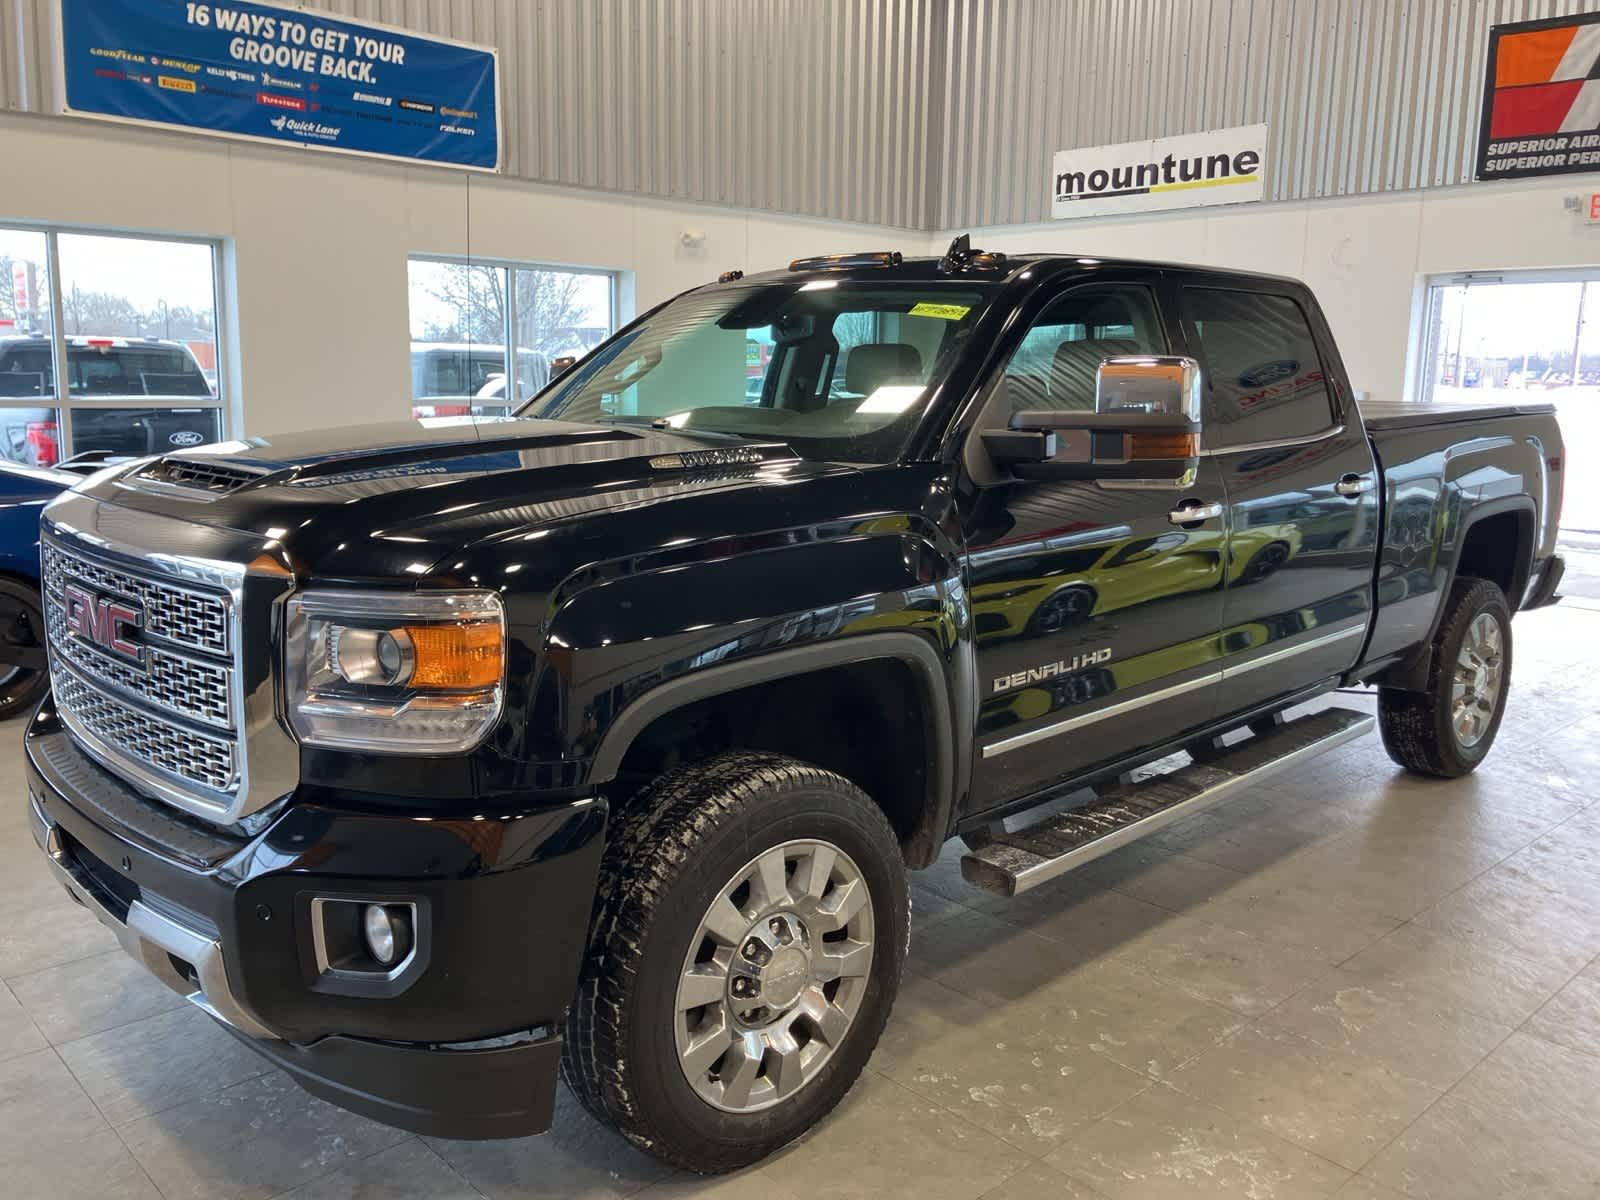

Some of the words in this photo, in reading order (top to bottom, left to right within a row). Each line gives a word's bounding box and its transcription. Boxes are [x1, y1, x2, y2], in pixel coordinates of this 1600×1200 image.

[186, 3, 210, 26] 16
[214, 8, 277, 39] WAYS
[279, 20, 307, 46] TO
[310, 28, 349, 53] GET
[354, 36, 405, 64] YOUR
[90, 47, 145, 64] GOODYEAR
[162, 59, 201, 73] DUNLOP
[229, 37, 317, 73] GROOVE
[320, 55, 377, 84] BACK.
[286, 119, 316, 133] Quick
[315, 123, 341, 137] Lane
[439, 124, 475, 136] FALKEN
[1487, 137, 1568, 156] SUPERIOR
[1569, 134, 1600, 148] AIR
[1056, 150, 1260, 195] mountune
[1485, 154, 1567, 172] SUPERIOR
[1568, 151, 1600, 166] PER
[64, 584, 145, 662] GMC
[992, 656, 1079, 693] DENALI
[1081, 647, 1112, 668] HD
